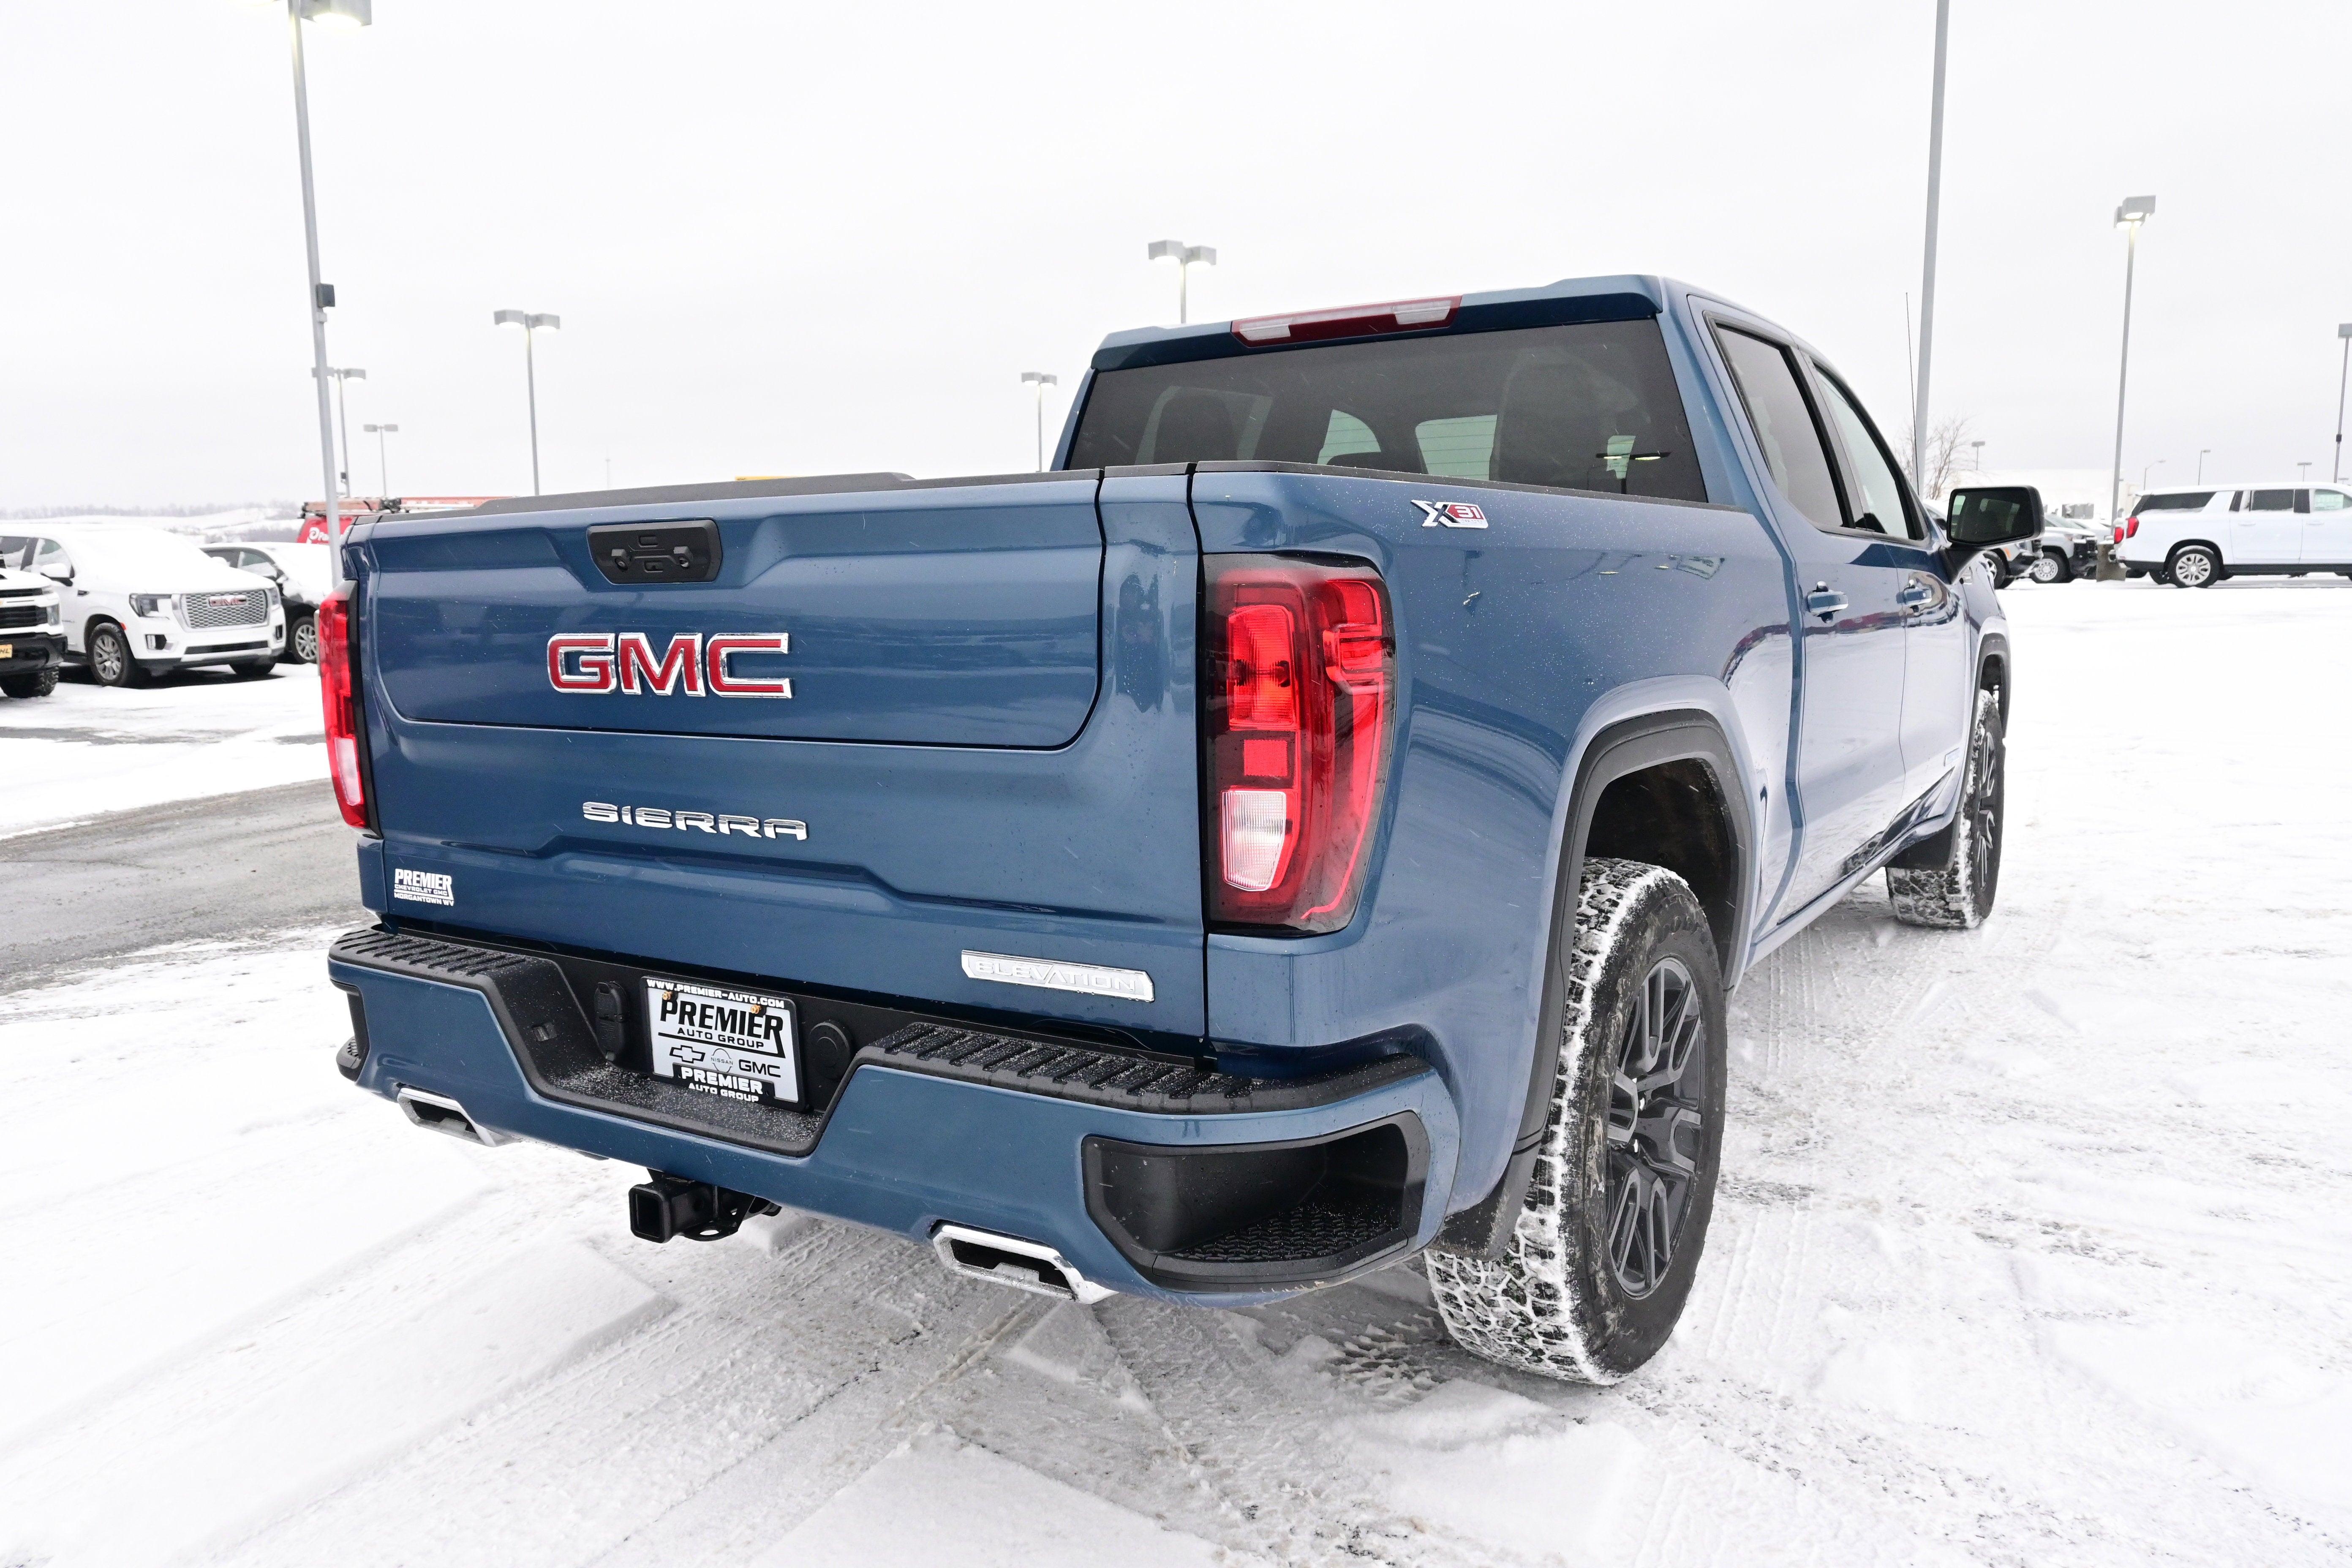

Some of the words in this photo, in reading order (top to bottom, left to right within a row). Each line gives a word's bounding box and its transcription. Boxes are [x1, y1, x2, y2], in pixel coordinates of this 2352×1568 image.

[547, 632, 793, 699] GMC
[583, 801, 808, 841] SIERRA
[394, 884, 432, 895] CHEVROLET
[395, 868, 453, 894] PREMIER
[394, 892, 442, 905] MORGANTOWN
[975, 961, 1136, 992] ELEVATION
[646, 979, 785, 1009] WWW.PREMIER-AUTO.COM
[660, 999, 785, 1048] PREMIER
[677, 1027, 713, 1040] AUTO
[718, 1034, 764, 1049] GROUP
[710, 1056, 733, 1065] NISSAN
[738, 1059, 781, 1078] GMC
[681, 1067, 763, 1095] PREMIER
[688, 1082, 718, 1095] AUTO
[720, 1089, 760, 1103] GROUP
